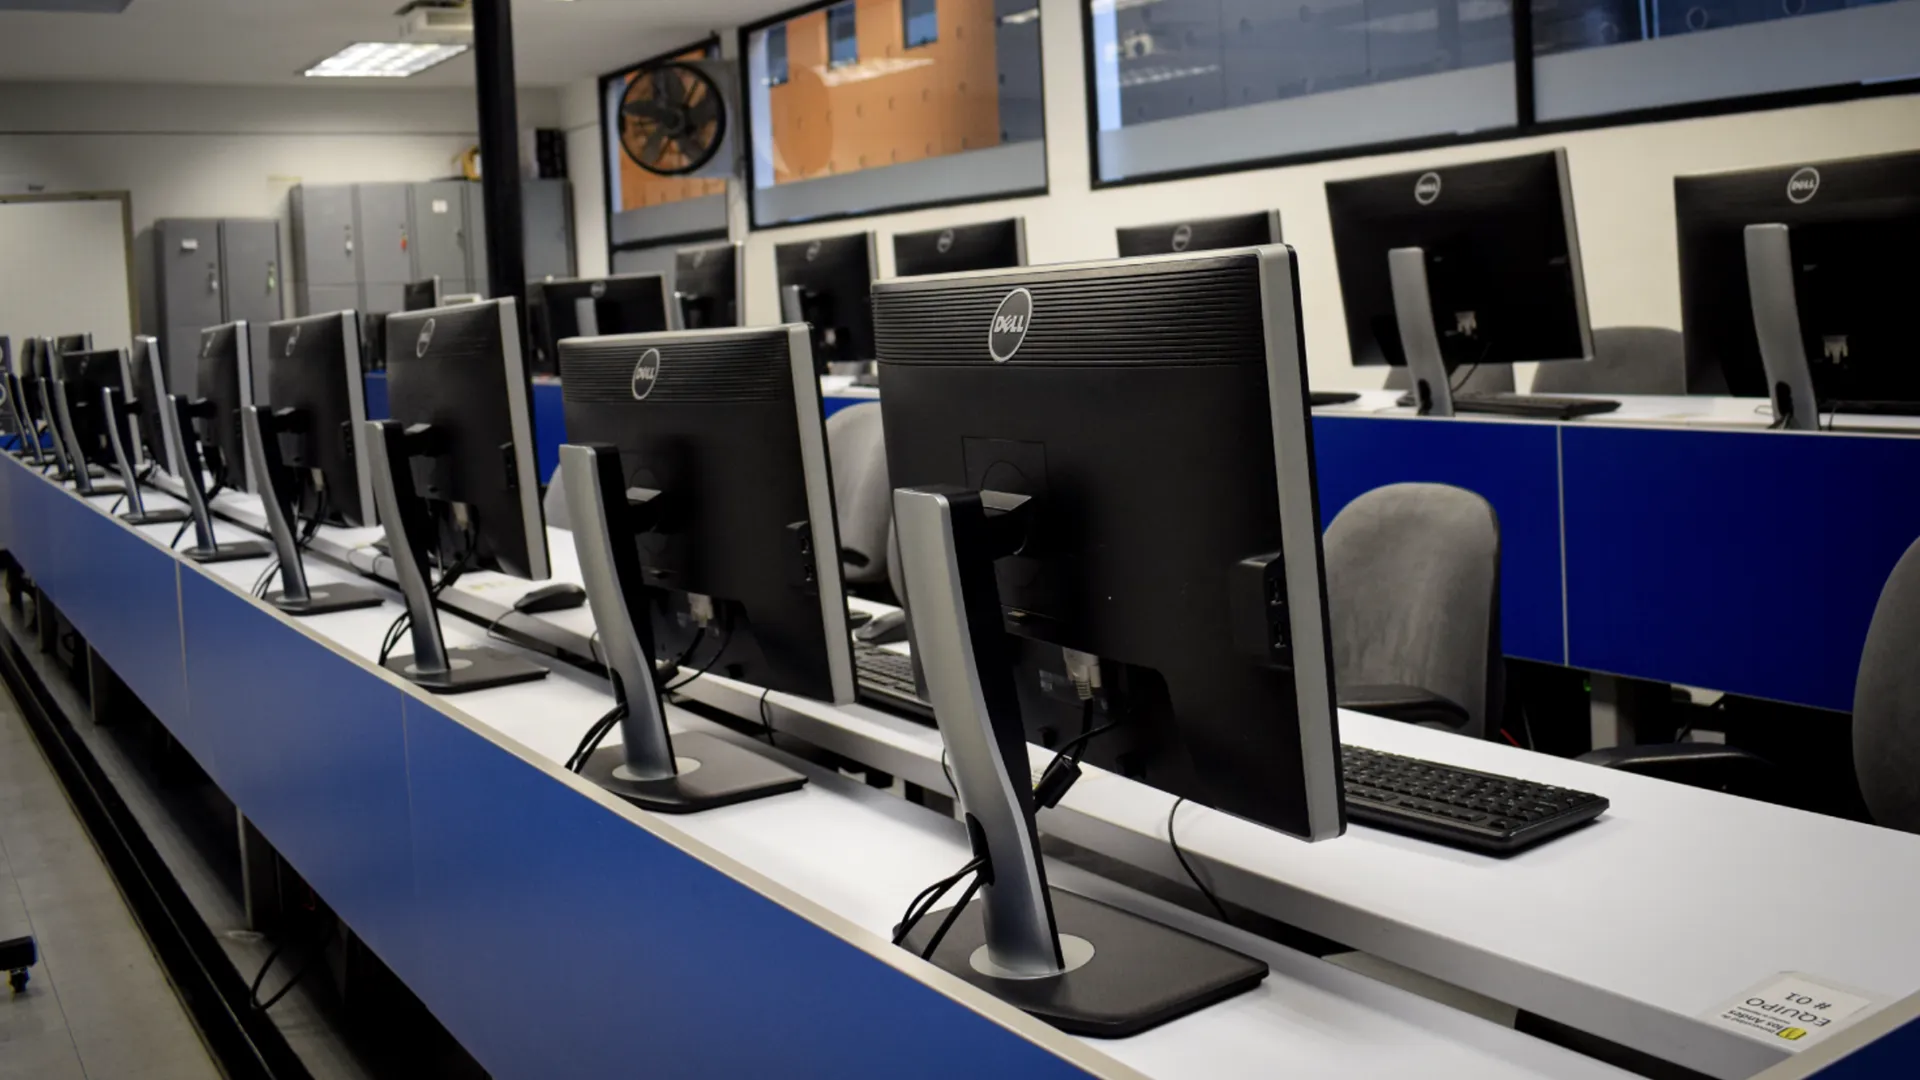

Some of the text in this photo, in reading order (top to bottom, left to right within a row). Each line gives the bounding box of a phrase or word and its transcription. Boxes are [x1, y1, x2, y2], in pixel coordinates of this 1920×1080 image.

[1792, 178, 1814, 190] DELL
[993, 314, 1025, 333] DELL
[636, 366, 655, 380] DELL
[1785, 992, 1832, 1010] # 01
[1727, 1010, 1765, 1024] Andes
[1746, 998, 1831, 1027] EQUIPO
[1767, 1020, 1784, 1030] los
